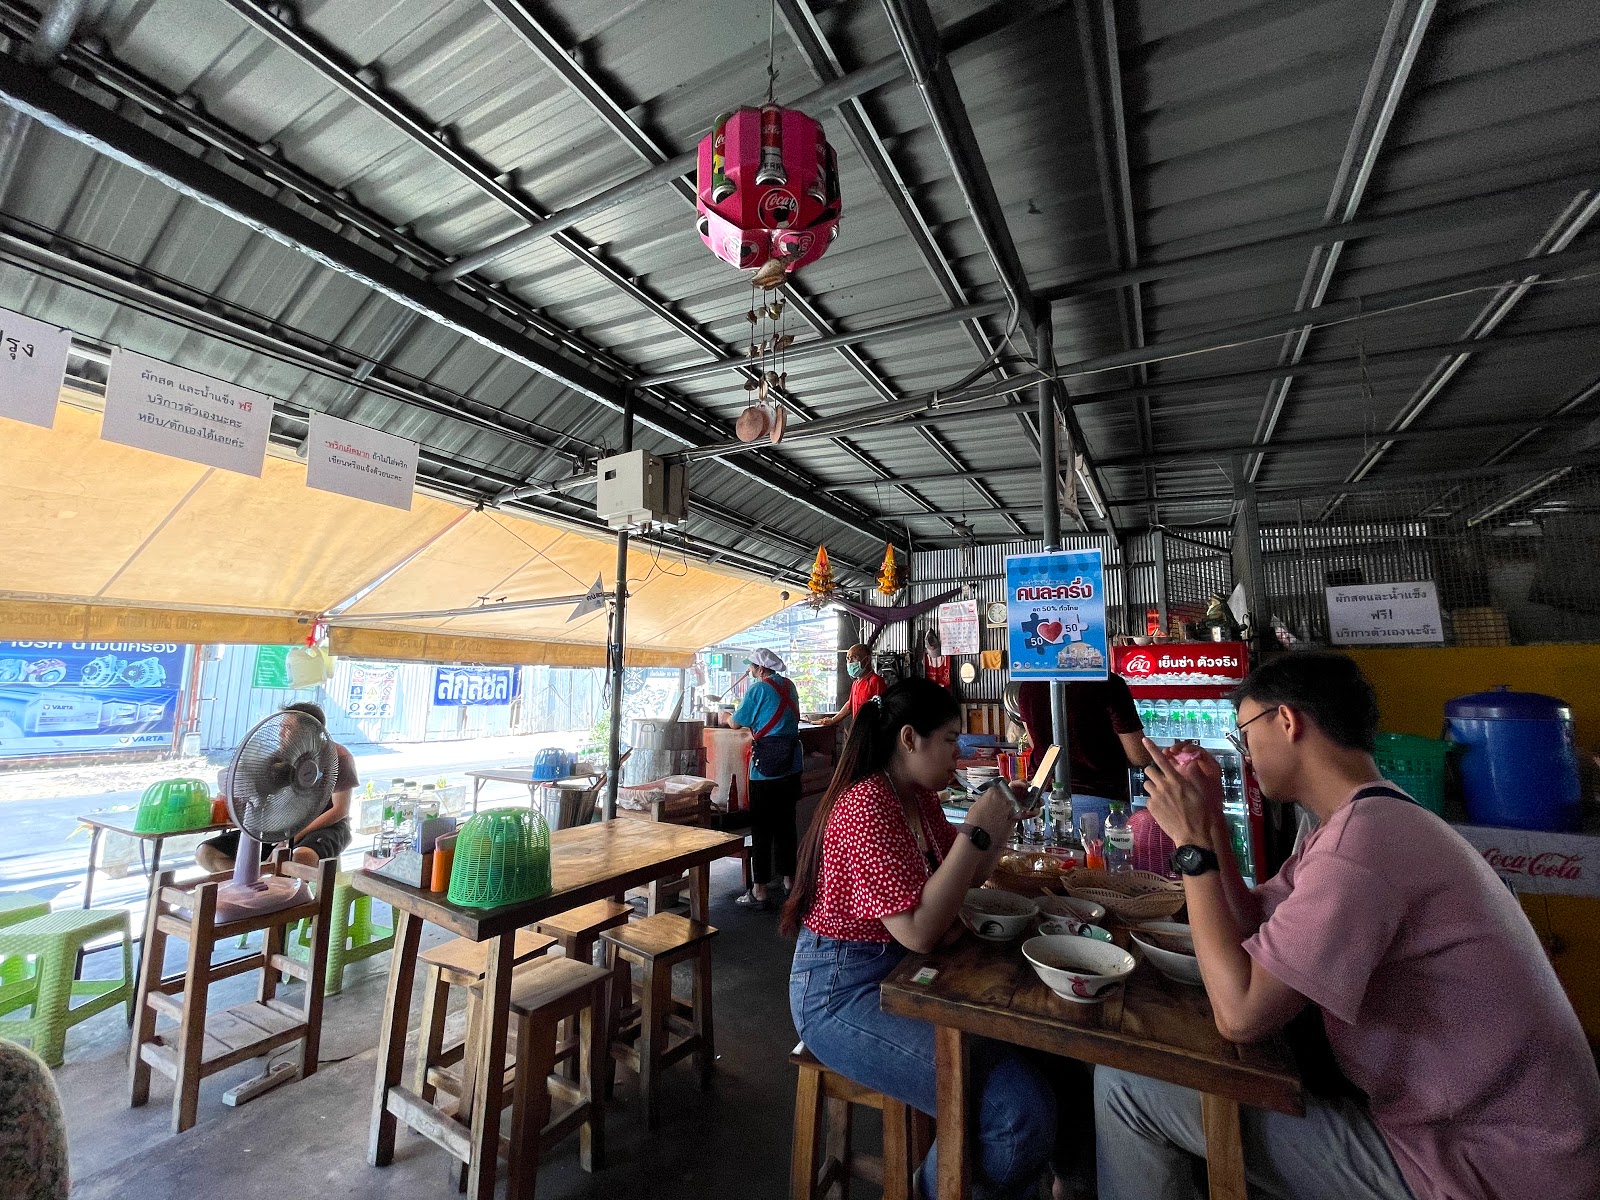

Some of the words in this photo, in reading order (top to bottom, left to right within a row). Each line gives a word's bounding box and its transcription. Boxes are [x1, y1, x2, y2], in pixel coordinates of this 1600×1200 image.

[0, 329, 35, 361] รุง
[140, 369, 175, 388] ผักสด
[238, 401, 253, 413] ฟรี
[1016, 576, 1093, 601] คนละครึ่ง
[1335, 587, 1427, 603] ผักสดและน้ำแข็ง
[1065, 624, 1078, 633] 50
[1030, 637, 1044, 646] 50
[1158, 655, 1194, 668] เย็นซ่า
[1197, 656, 1238, 668] ตัวจริง
[437, 673, 508, 705] สกุลชล
[132, 735, 164, 743] VARTA
